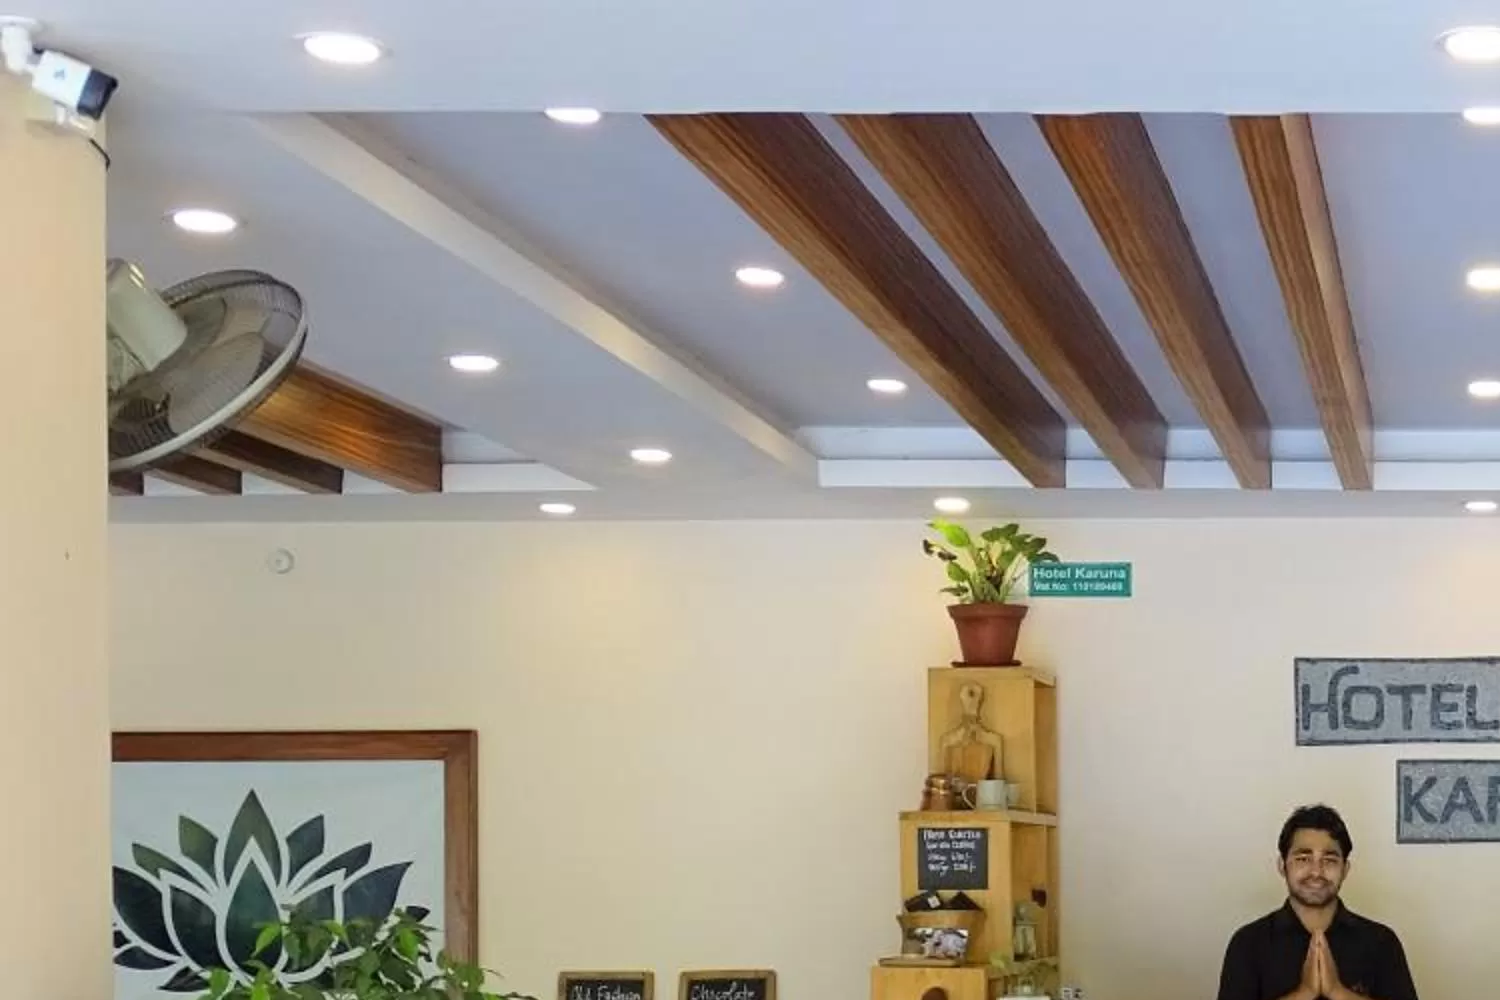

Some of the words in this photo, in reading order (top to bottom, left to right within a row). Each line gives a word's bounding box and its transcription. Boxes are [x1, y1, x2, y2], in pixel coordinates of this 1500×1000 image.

[1033, 567, 1071, 579] Hotel
[1075, 567, 1126, 579] Karuna
[1301, 665, 1500, 732] HOTEL
